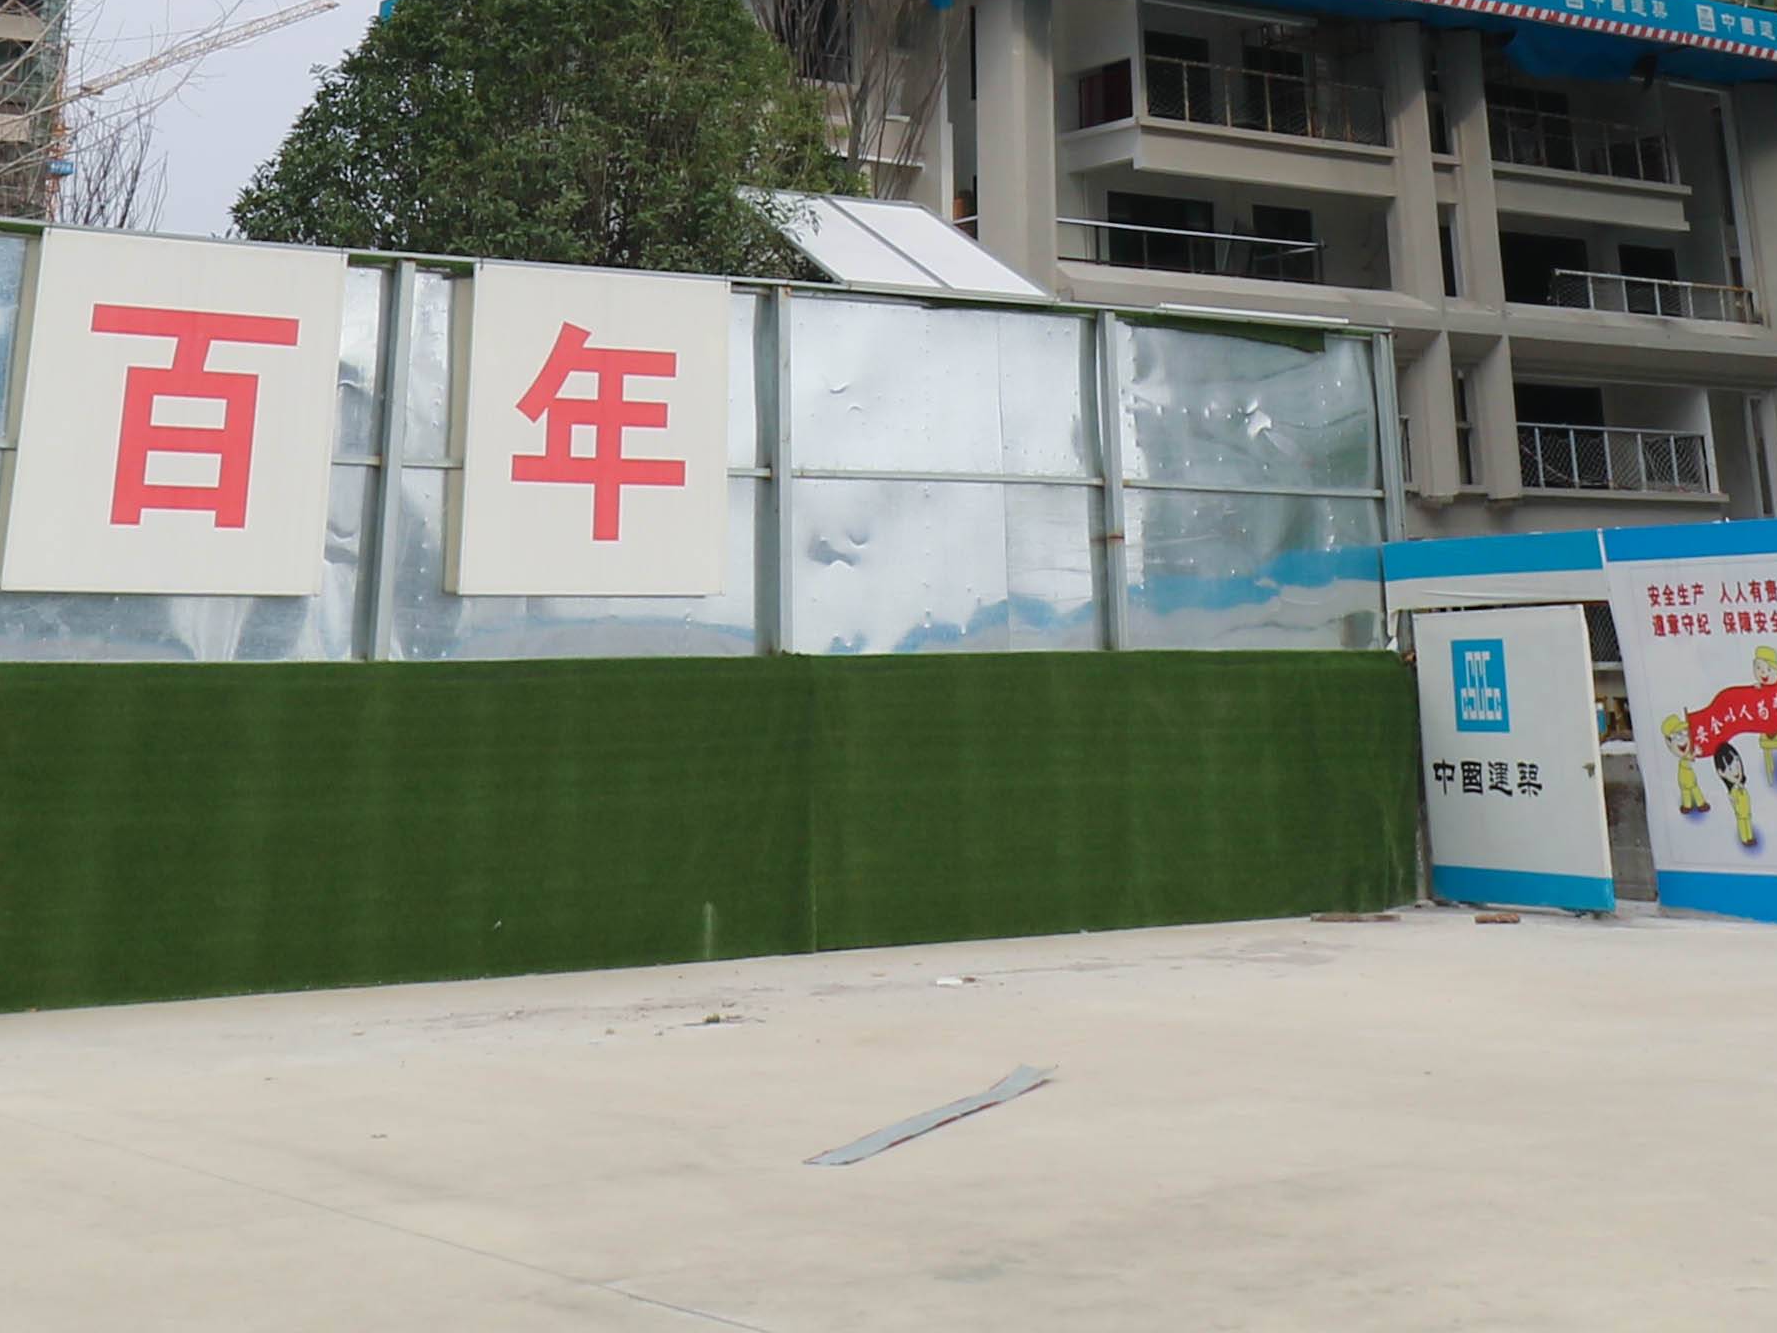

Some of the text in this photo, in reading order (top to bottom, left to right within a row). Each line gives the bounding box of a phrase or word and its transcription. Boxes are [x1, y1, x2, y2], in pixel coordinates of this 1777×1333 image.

[1647, 582, 1705, 607] 安全生产
[1652, 613, 1712, 637] 遵章守纪
